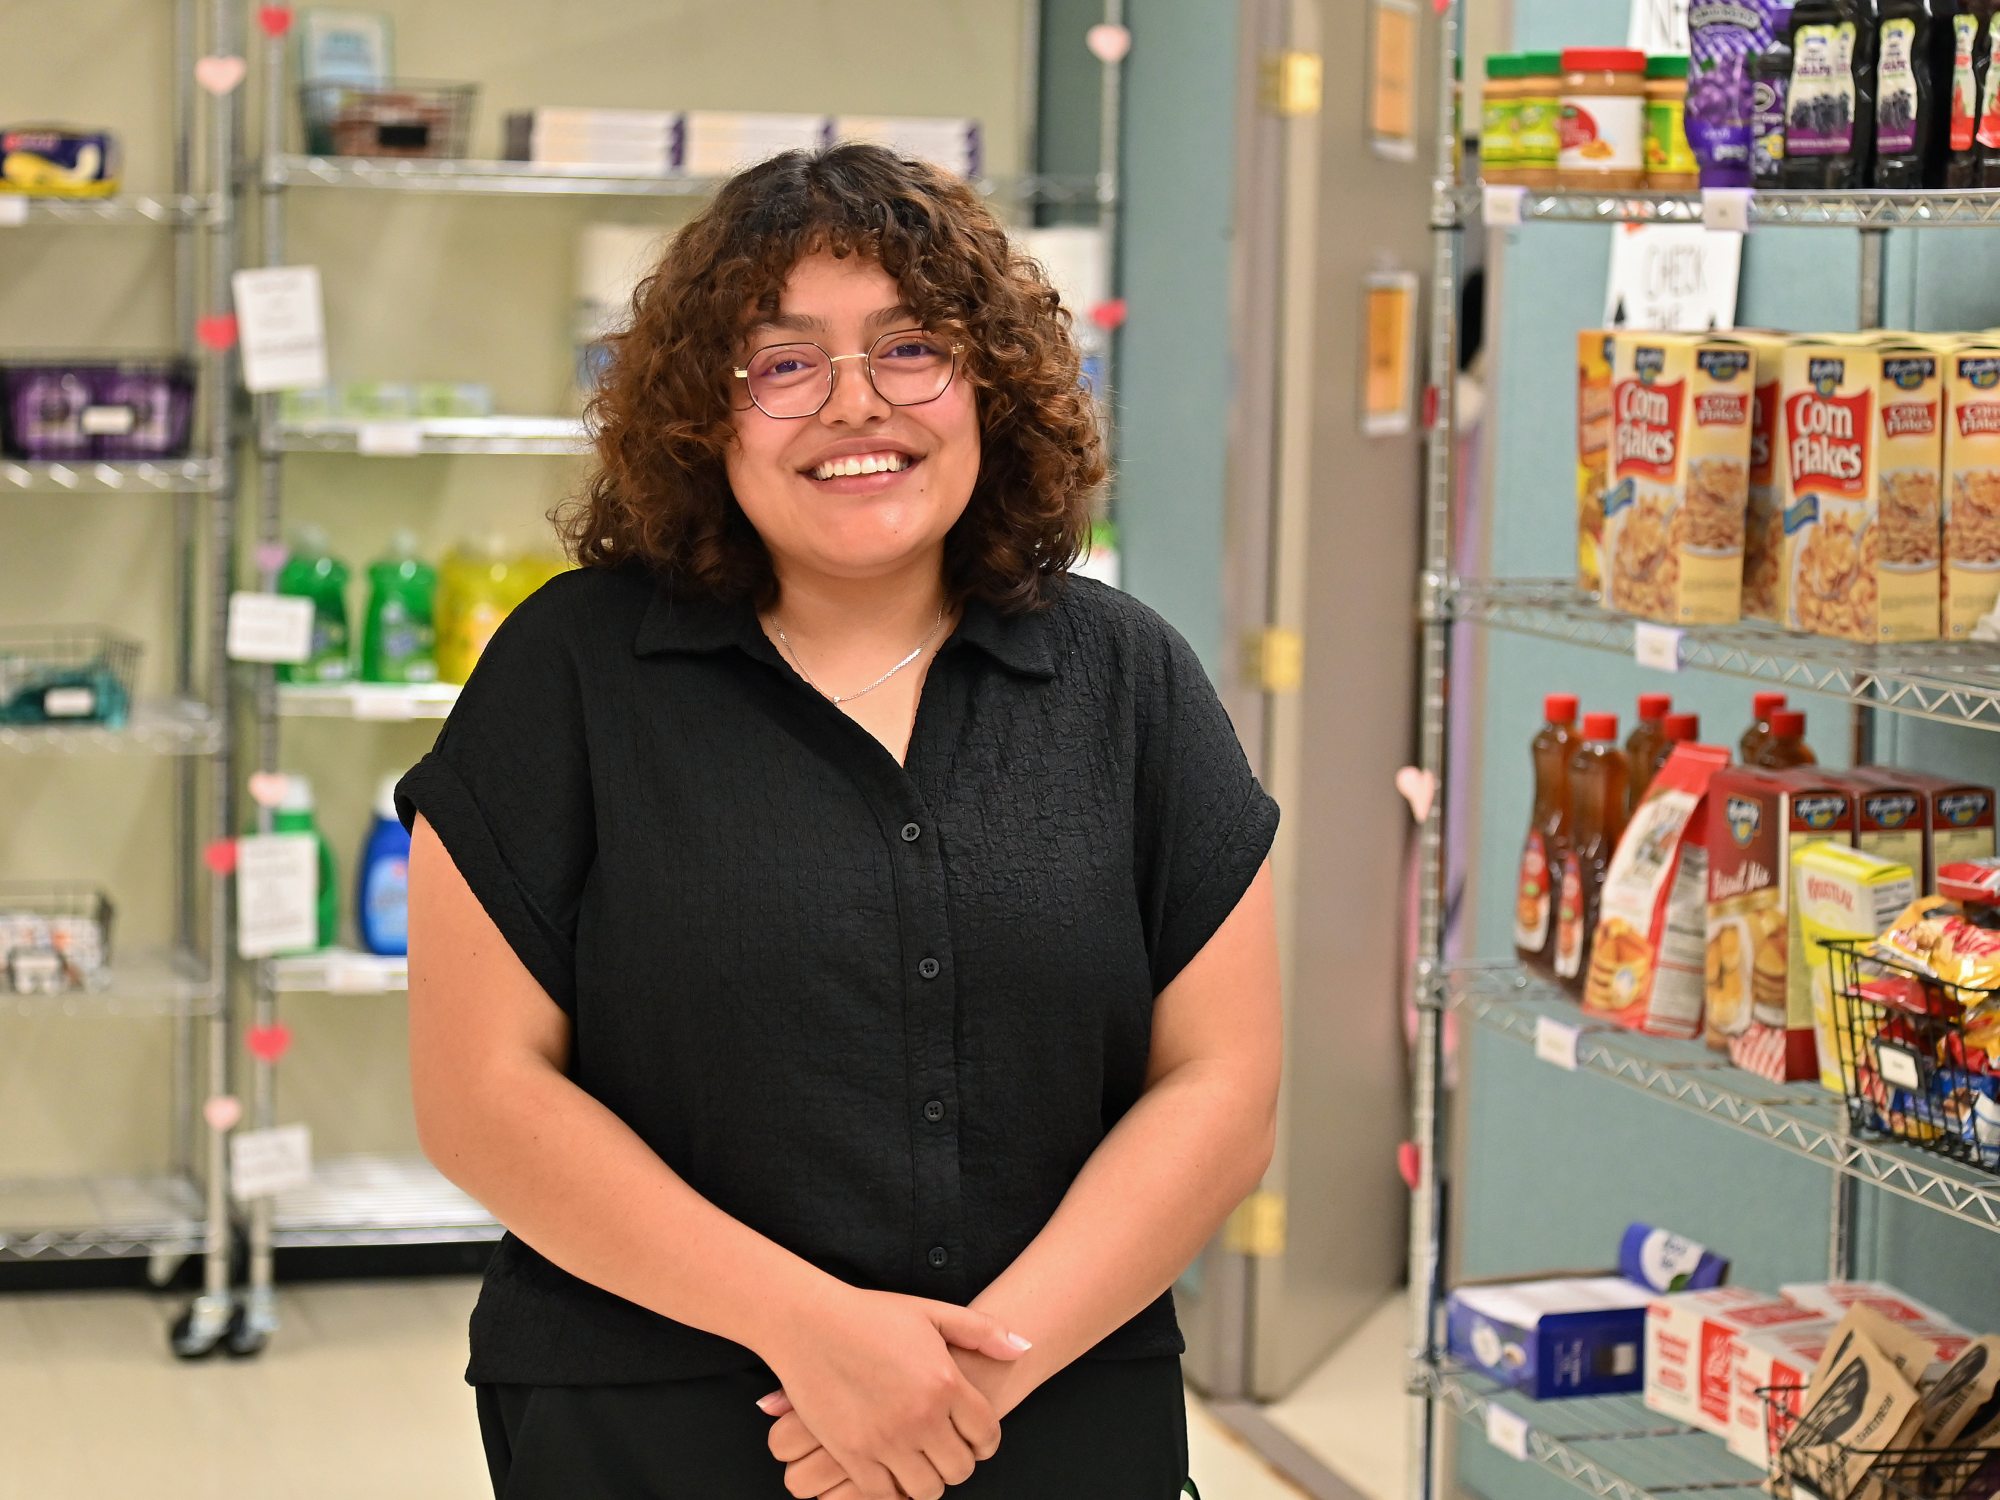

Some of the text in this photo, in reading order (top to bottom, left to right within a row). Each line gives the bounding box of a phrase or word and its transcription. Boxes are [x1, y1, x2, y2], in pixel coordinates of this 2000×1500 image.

[1618, 381, 1670, 426] Corn
[1794, 394, 1853, 440] Corn
[1615, 420, 1676, 467] Flakes
[1791, 436, 1863, 482] Flakes
